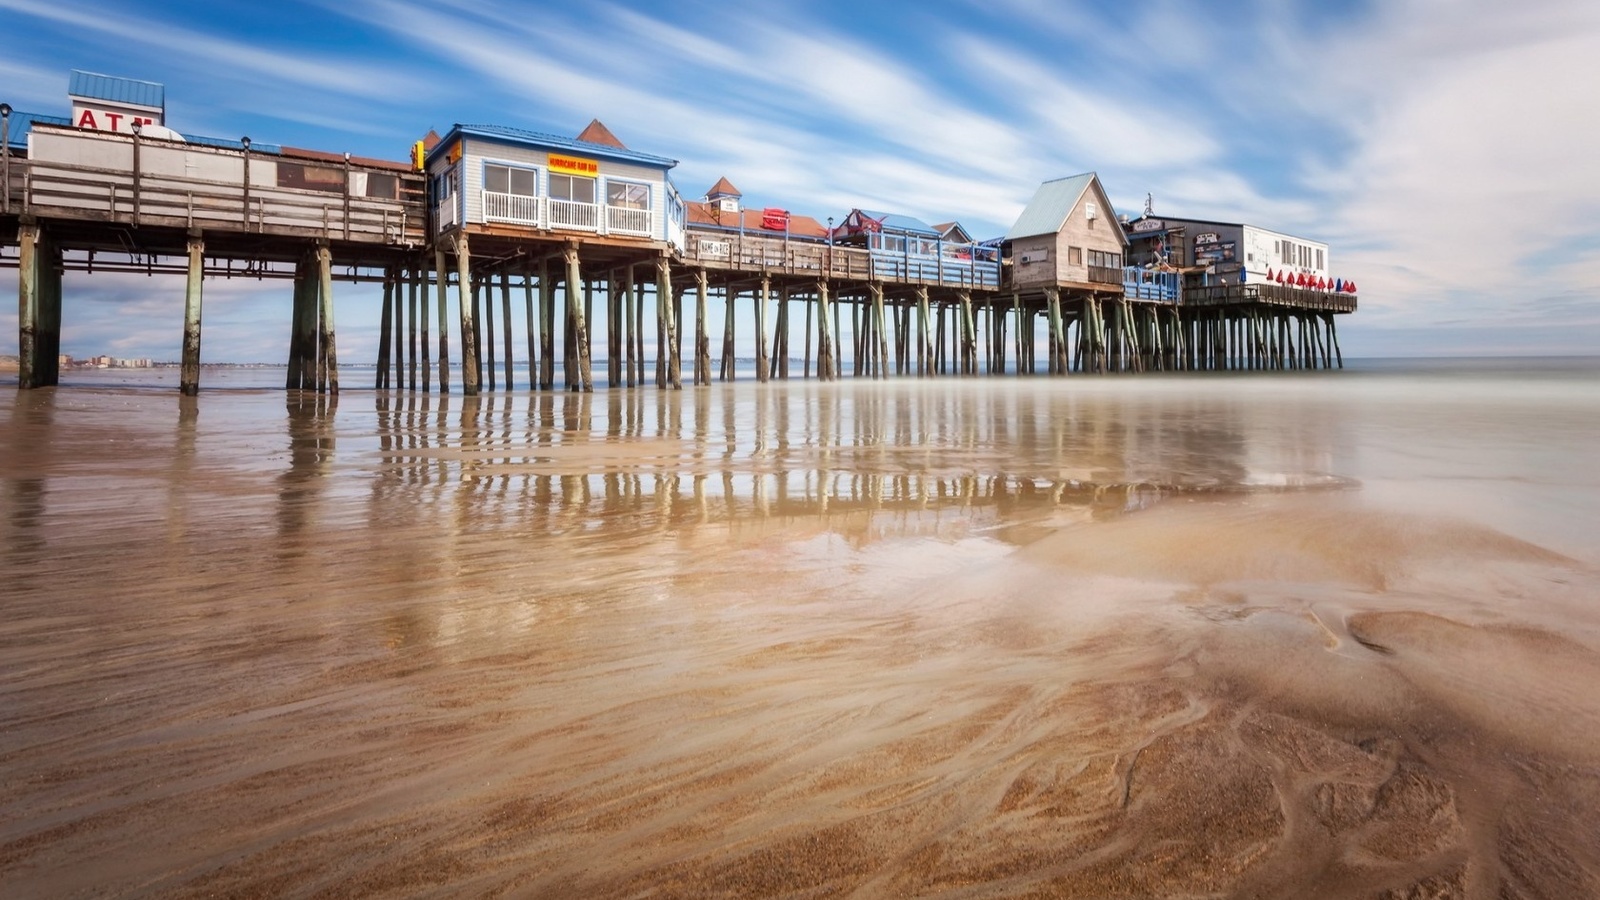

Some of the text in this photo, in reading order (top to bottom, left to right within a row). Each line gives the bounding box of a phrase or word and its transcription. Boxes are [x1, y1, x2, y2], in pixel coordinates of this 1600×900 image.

[549, 158, 577, 169] HURRICANE
[588, 164, 597, 173] BAR
[701, 241, 714, 254] NAME
[719, 244, 729, 255] RICE
